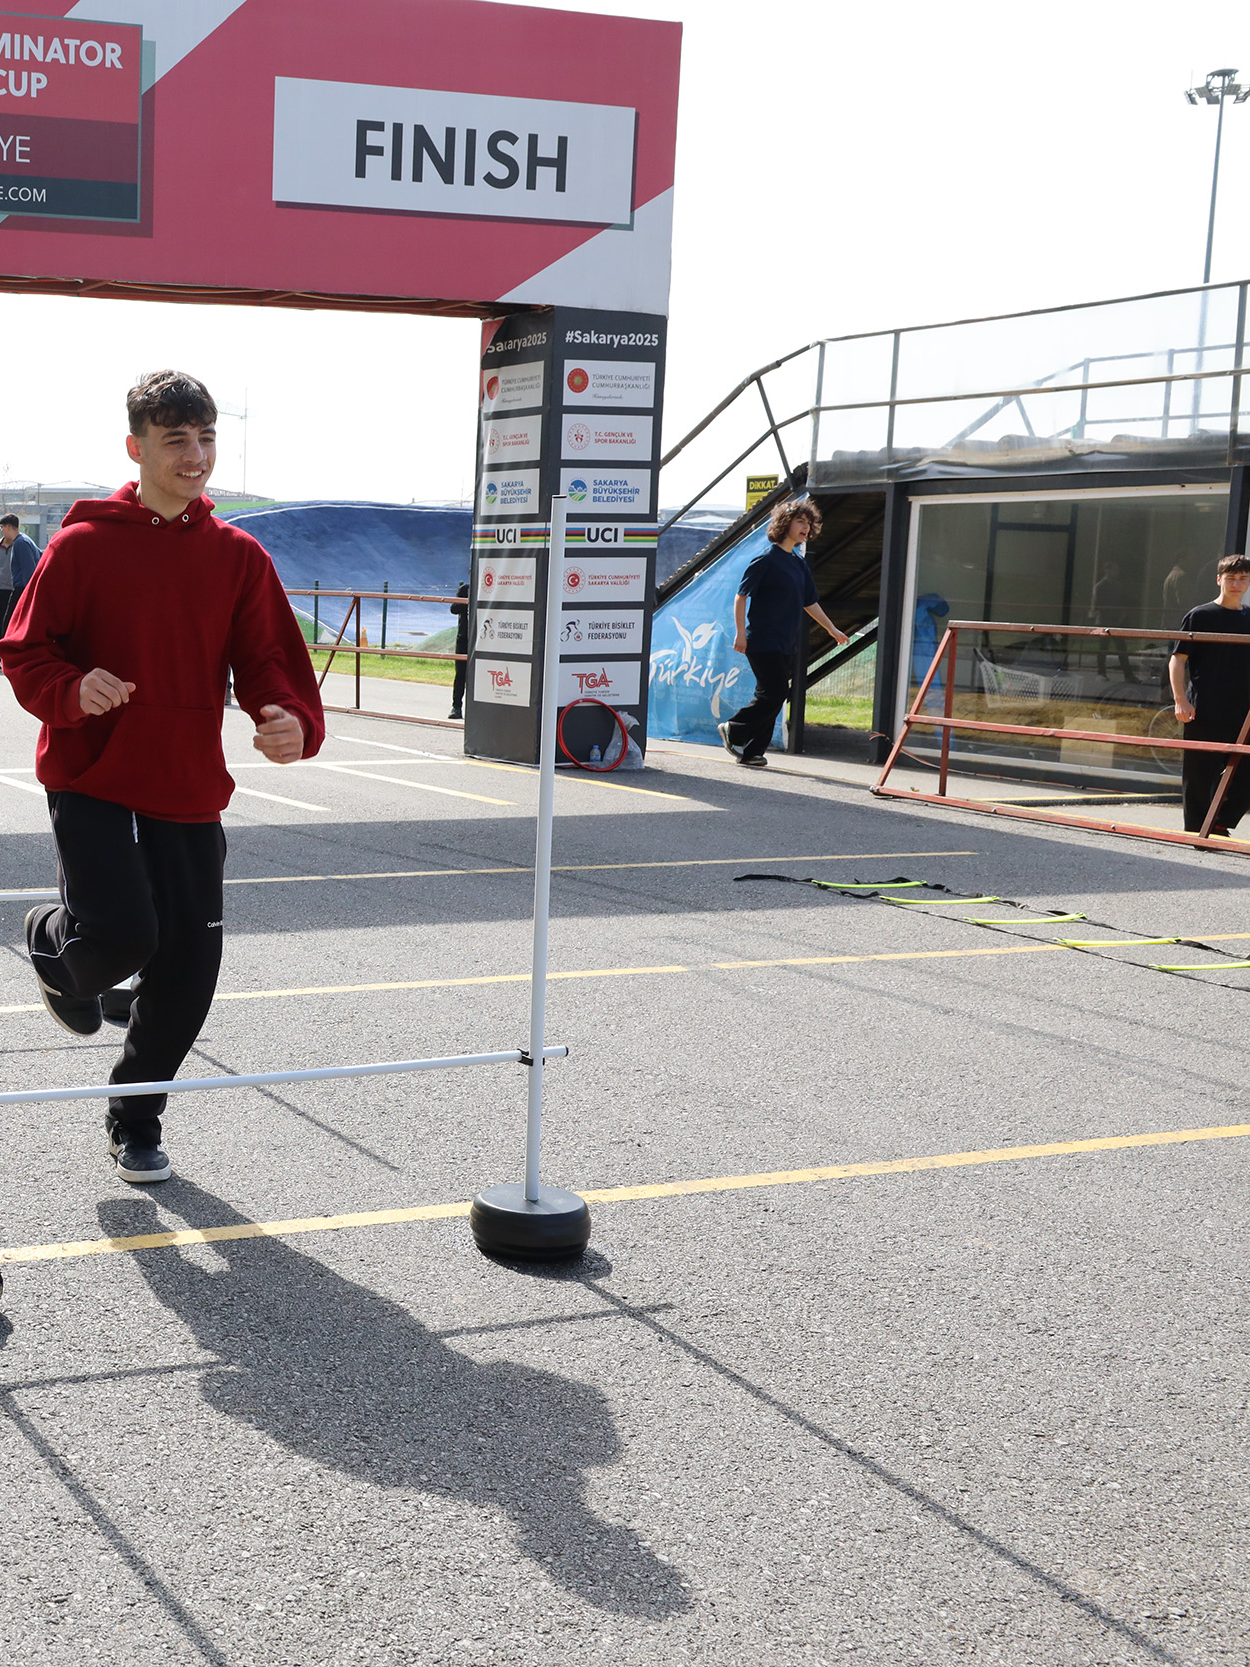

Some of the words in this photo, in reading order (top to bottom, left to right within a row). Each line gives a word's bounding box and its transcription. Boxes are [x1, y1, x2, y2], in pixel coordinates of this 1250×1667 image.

[355, 119, 568, 193] FINISH
[565, 330, 659, 348] #Sakarya2025
[592, 494, 635, 503] BELEDİYESİ
[593, 486, 640, 495] BÜYÜKŞEHİR
[496, 528, 516, 544] UCI
[587, 527, 618, 543] UCI
[588, 621, 611, 629] TÜRKİYE
[612, 621, 635, 629] BİSİKLET
[587, 632, 627, 640] FEDERASYONU
[488, 666, 513, 691] TGA
[571, 667, 613, 694] TGA
